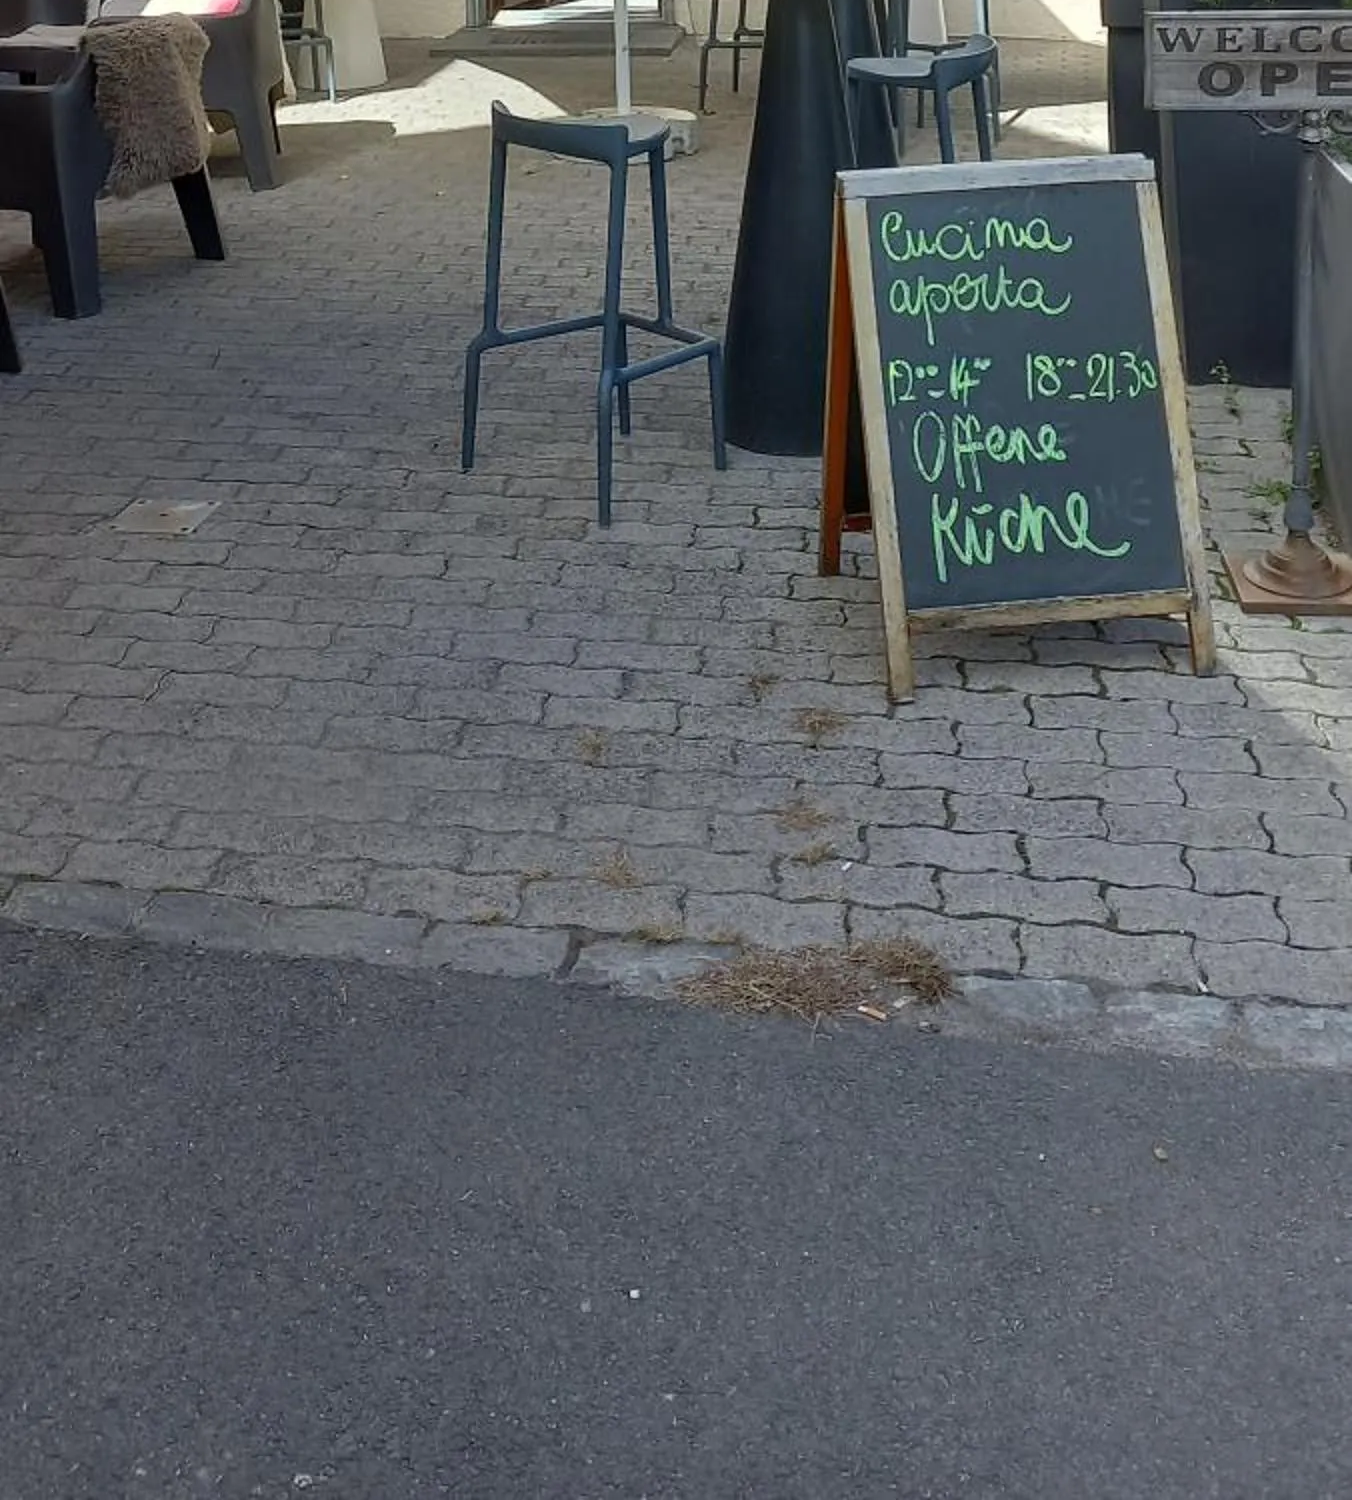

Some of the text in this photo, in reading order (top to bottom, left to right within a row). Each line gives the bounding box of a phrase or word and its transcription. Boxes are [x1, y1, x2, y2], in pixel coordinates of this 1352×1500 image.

[1198, 62, 1352, 97] OPE
[880, 211, 1074, 261] Cucina
[889, 266, 1072, 346] aperta
[913, 411, 1067, 492] Offene
